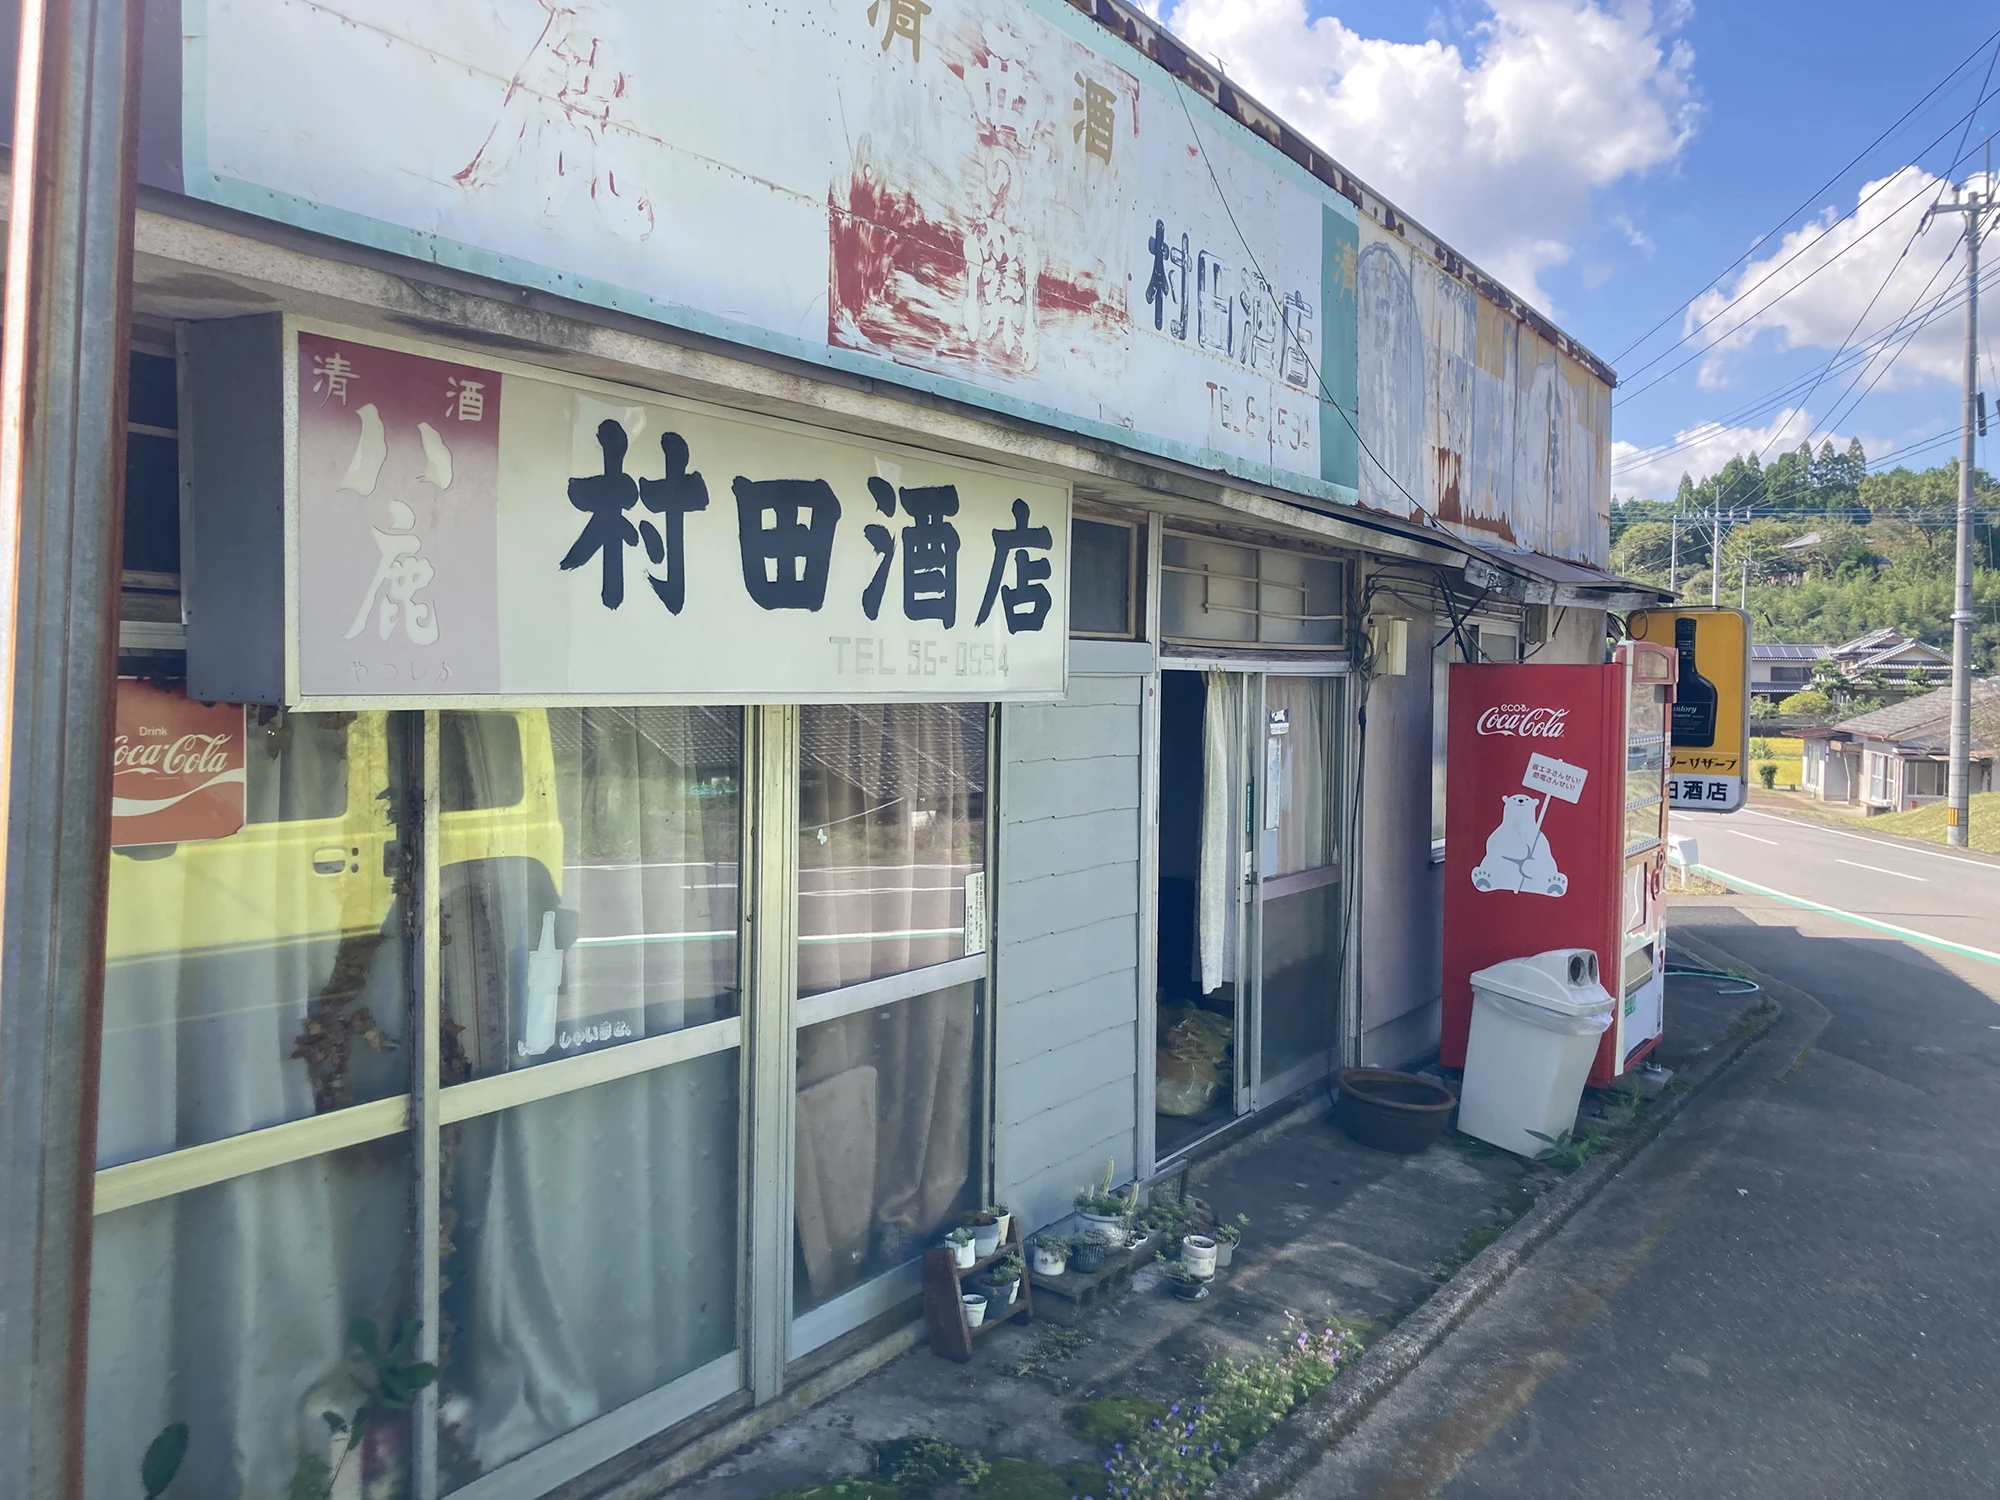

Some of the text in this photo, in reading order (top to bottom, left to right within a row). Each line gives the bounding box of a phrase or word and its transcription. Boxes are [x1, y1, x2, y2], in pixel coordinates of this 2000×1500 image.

[1073, 72, 1118, 166] 酒
[313, 352, 485, 422] 清 酒
[335, 402, 453, 647] 八鹿
[558, 418, 1054, 635] 村田酒店
[350, 661, 453, 684] やつしか
[829, 636, 896, 675] TEL
[139, 727, 168, 736] Drink
[1477, 707, 1571, 738] Coca-Cola
